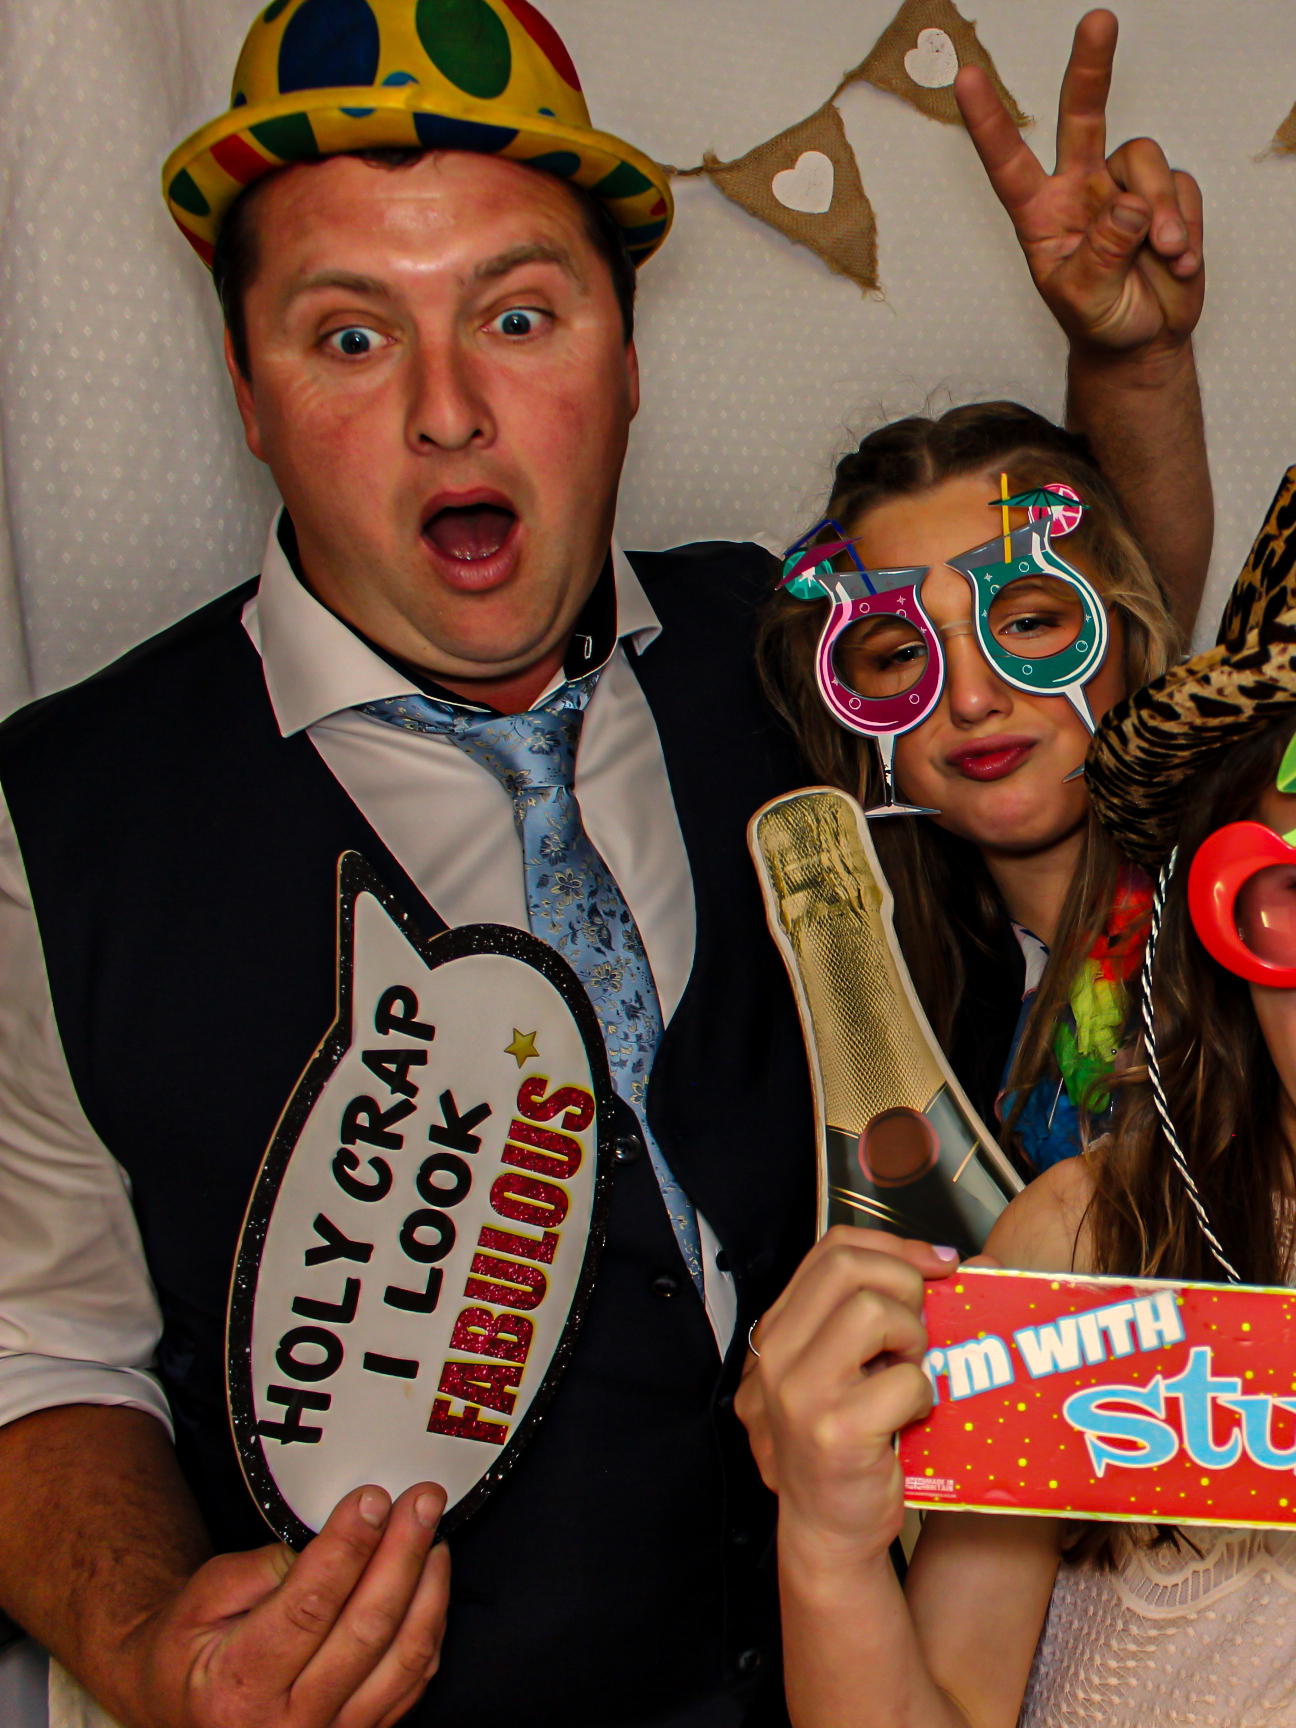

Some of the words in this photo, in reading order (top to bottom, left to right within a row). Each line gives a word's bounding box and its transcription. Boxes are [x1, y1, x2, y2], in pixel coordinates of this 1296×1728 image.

[258, 1213, 373, 1445] HOLY
[331, 984, 437, 1203] CRAP
[383, 1089, 493, 1314] LOOK
[426, 1075, 597, 1446] FABULOUS
[362, 1351, 420, 1380] I
[1013, 1291, 1185, 1379] WITH
